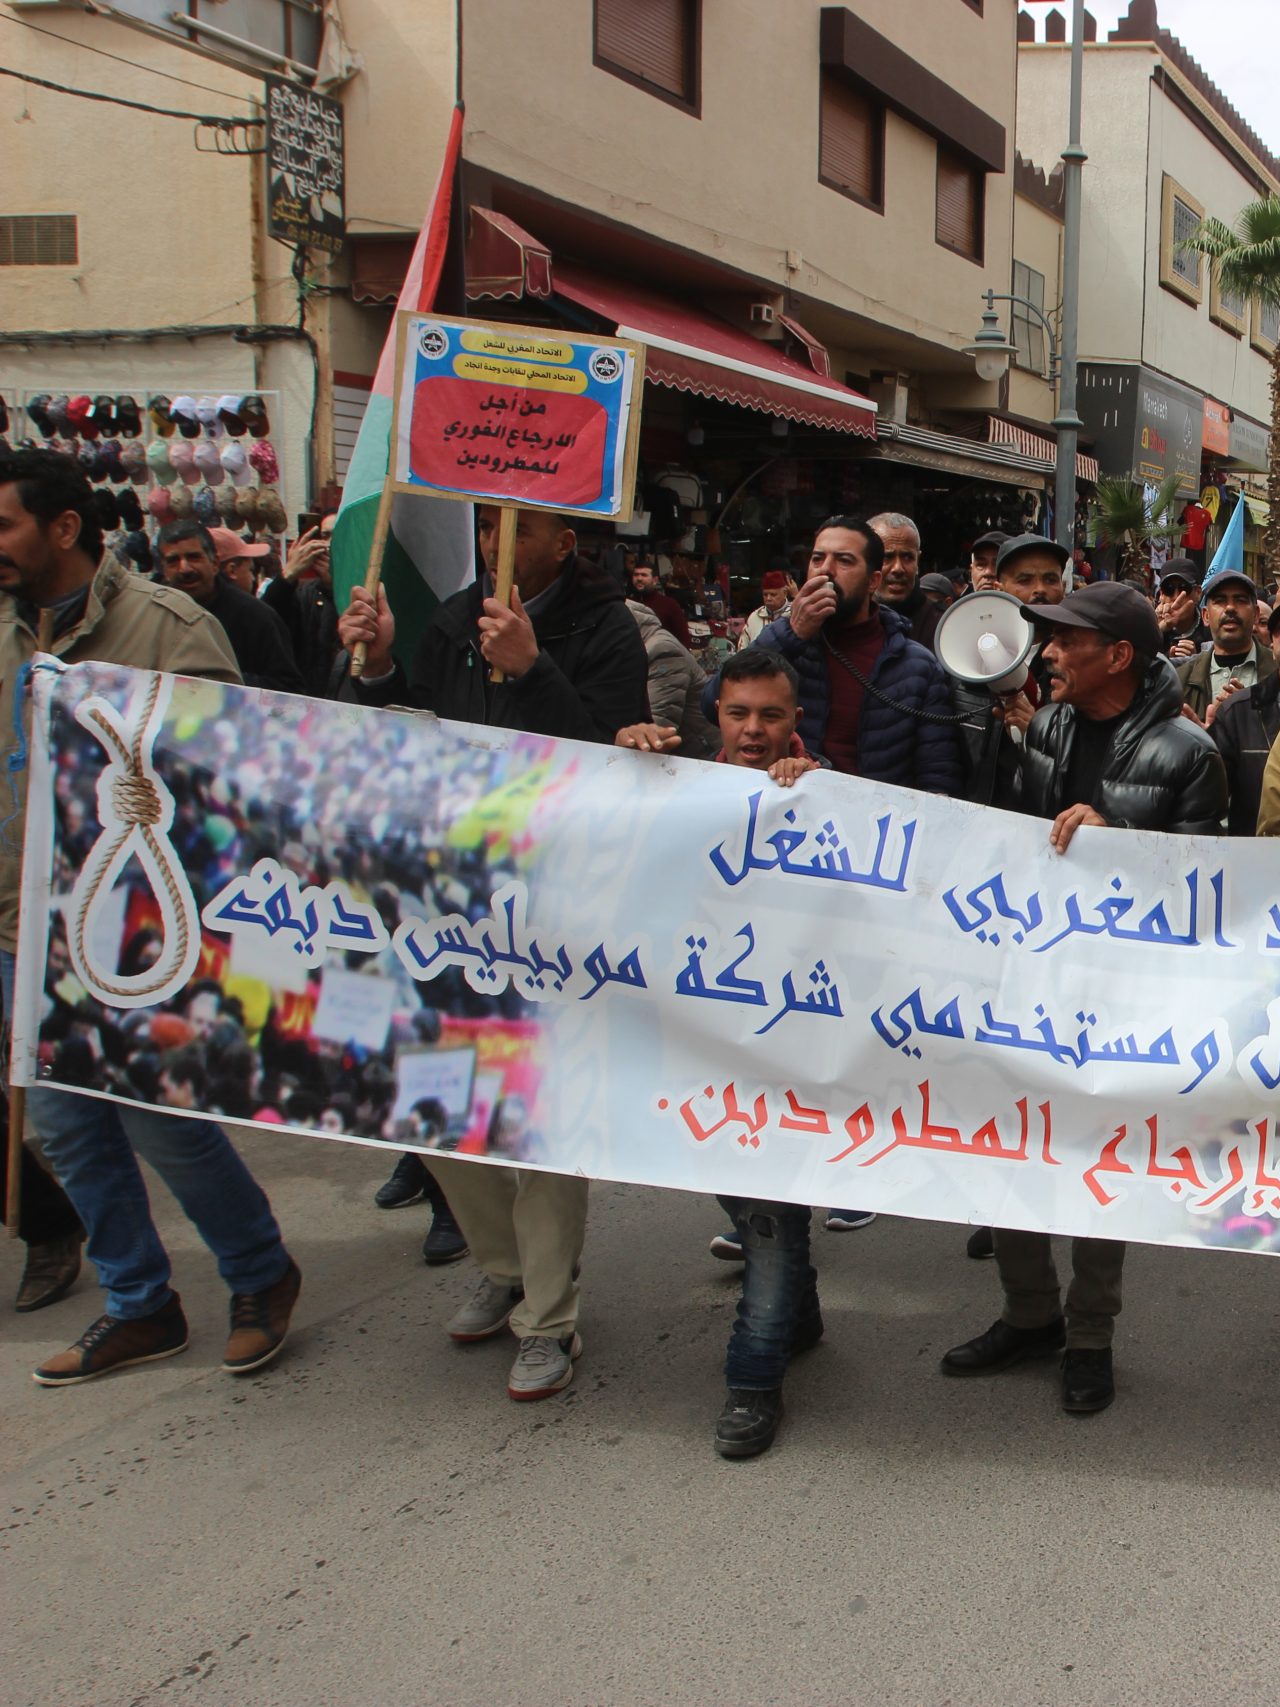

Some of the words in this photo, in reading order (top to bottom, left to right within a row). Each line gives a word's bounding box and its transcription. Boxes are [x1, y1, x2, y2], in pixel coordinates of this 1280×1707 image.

[507, 343, 534, 354] المغربي
[536, 347, 562, 357] الاتحاد
[484, 363, 501, 374] وجدة
[553, 371, 576, 382] الاتحاد
[480, 392, 518, 415] أجل
[519, 399, 546, 416] من
[443, 420, 506, 441] الفوري
[456, 449, 560, 475] للمطرودين
[709, 790, 917, 892] للشغل
[215, 871, 377, 954] ديف
[943, 868, 1235, 953] المغربي
[406, 898, 646, 1000] موبيليس
[674, 923, 843, 1034] شركة
[871, 987, 1219, 1094] ومستخدمي
